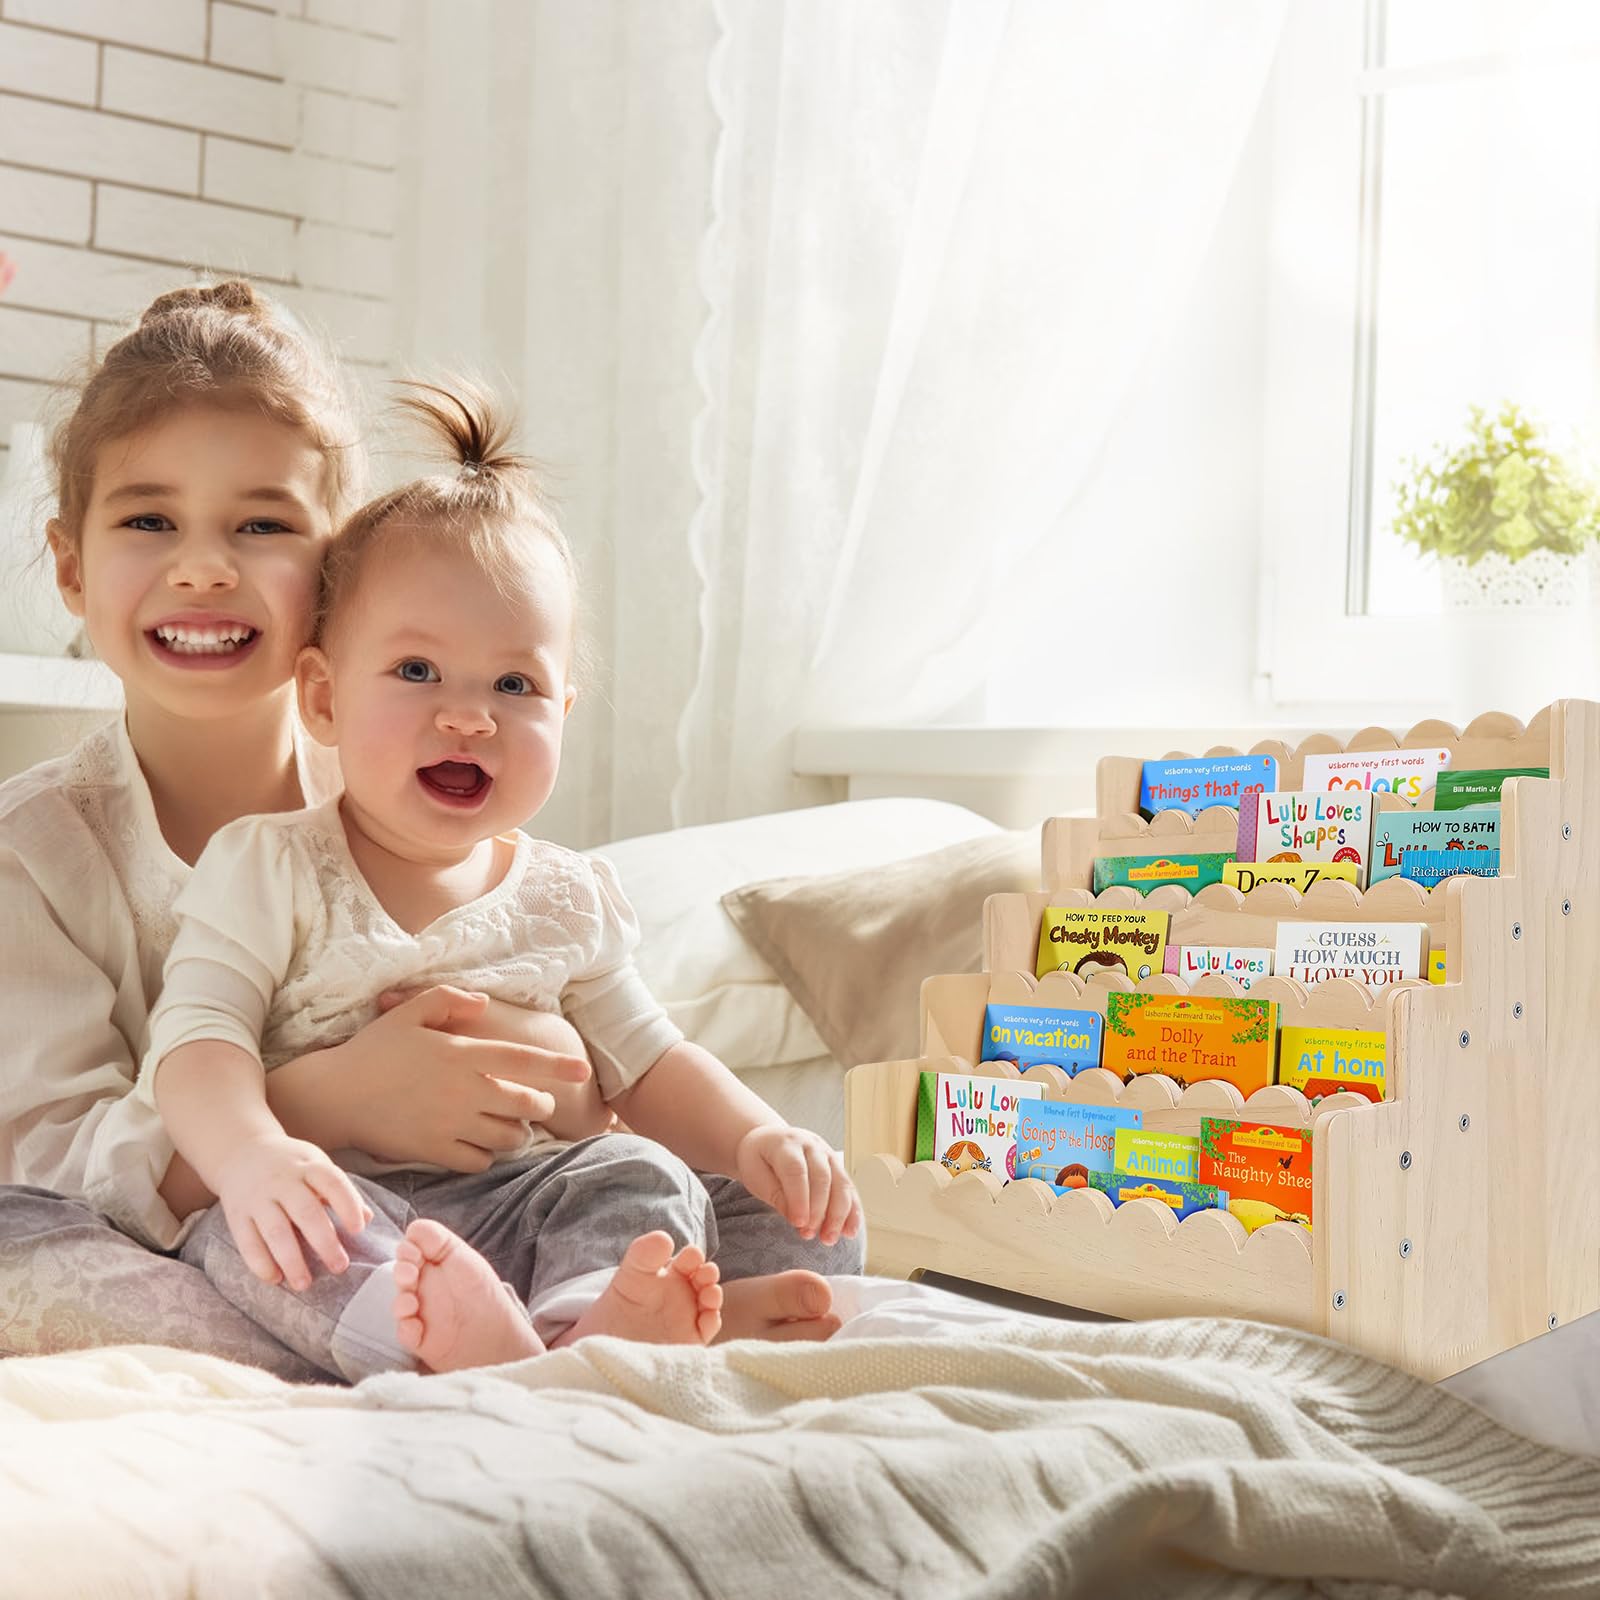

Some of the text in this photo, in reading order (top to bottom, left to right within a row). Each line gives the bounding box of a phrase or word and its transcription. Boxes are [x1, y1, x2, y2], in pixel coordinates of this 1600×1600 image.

[1211, 764, 1229, 773] first
[1230, 763, 1252, 772] words
[1380, 758, 1400, 767] first
[1401, 757, 1425, 765] words
[1148, 783, 1200, 803] Things
[1204, 780, 1240, 797] that
[1466, 785, 1488, 793] Martin
[1489, 785, 1497, 793] Jr
[1266, 795, 1362, 825] Lulu Loves
[1280, 823, 1346, 851] Shapes
[1412, 821, 1496, 834] HOW TO BATH
[1411, 866, 1460, 877] Richard
[1065, 913, 1147, 924] HOW TO FEED YOUR
[1050, 925, 1161, 955] Cheeky Monkey
[1319, 932, 1376, 947] GUESS
[1187, 950, 1264, 973] Lulu Loves
[1293, 949, 1400, 966] HOW MUCH
[1061, 1019, 1080, 1027] words
[1145, 1010, 1171, 1018] Usborne
[1173, 1012, 1203, 1020] Farmyard
[1014, 1027, 1090, 1050] vacation
[1161, 1027, 1204, 1048] Dolly
[1354, 1040, 1372, 1048] first
[1127, 1046, 1237, 1067] and the Train
[1297, 1050, 1385, 1078] At hom
[945, 1081, 1019, 1113] Lulu Lov
[1021, 1117, 1115, 1160] Going to the Hosp
[1228, 1152, 1247, 1164] The
[1213, 1162, 1312, 1189] Naughty Shee
